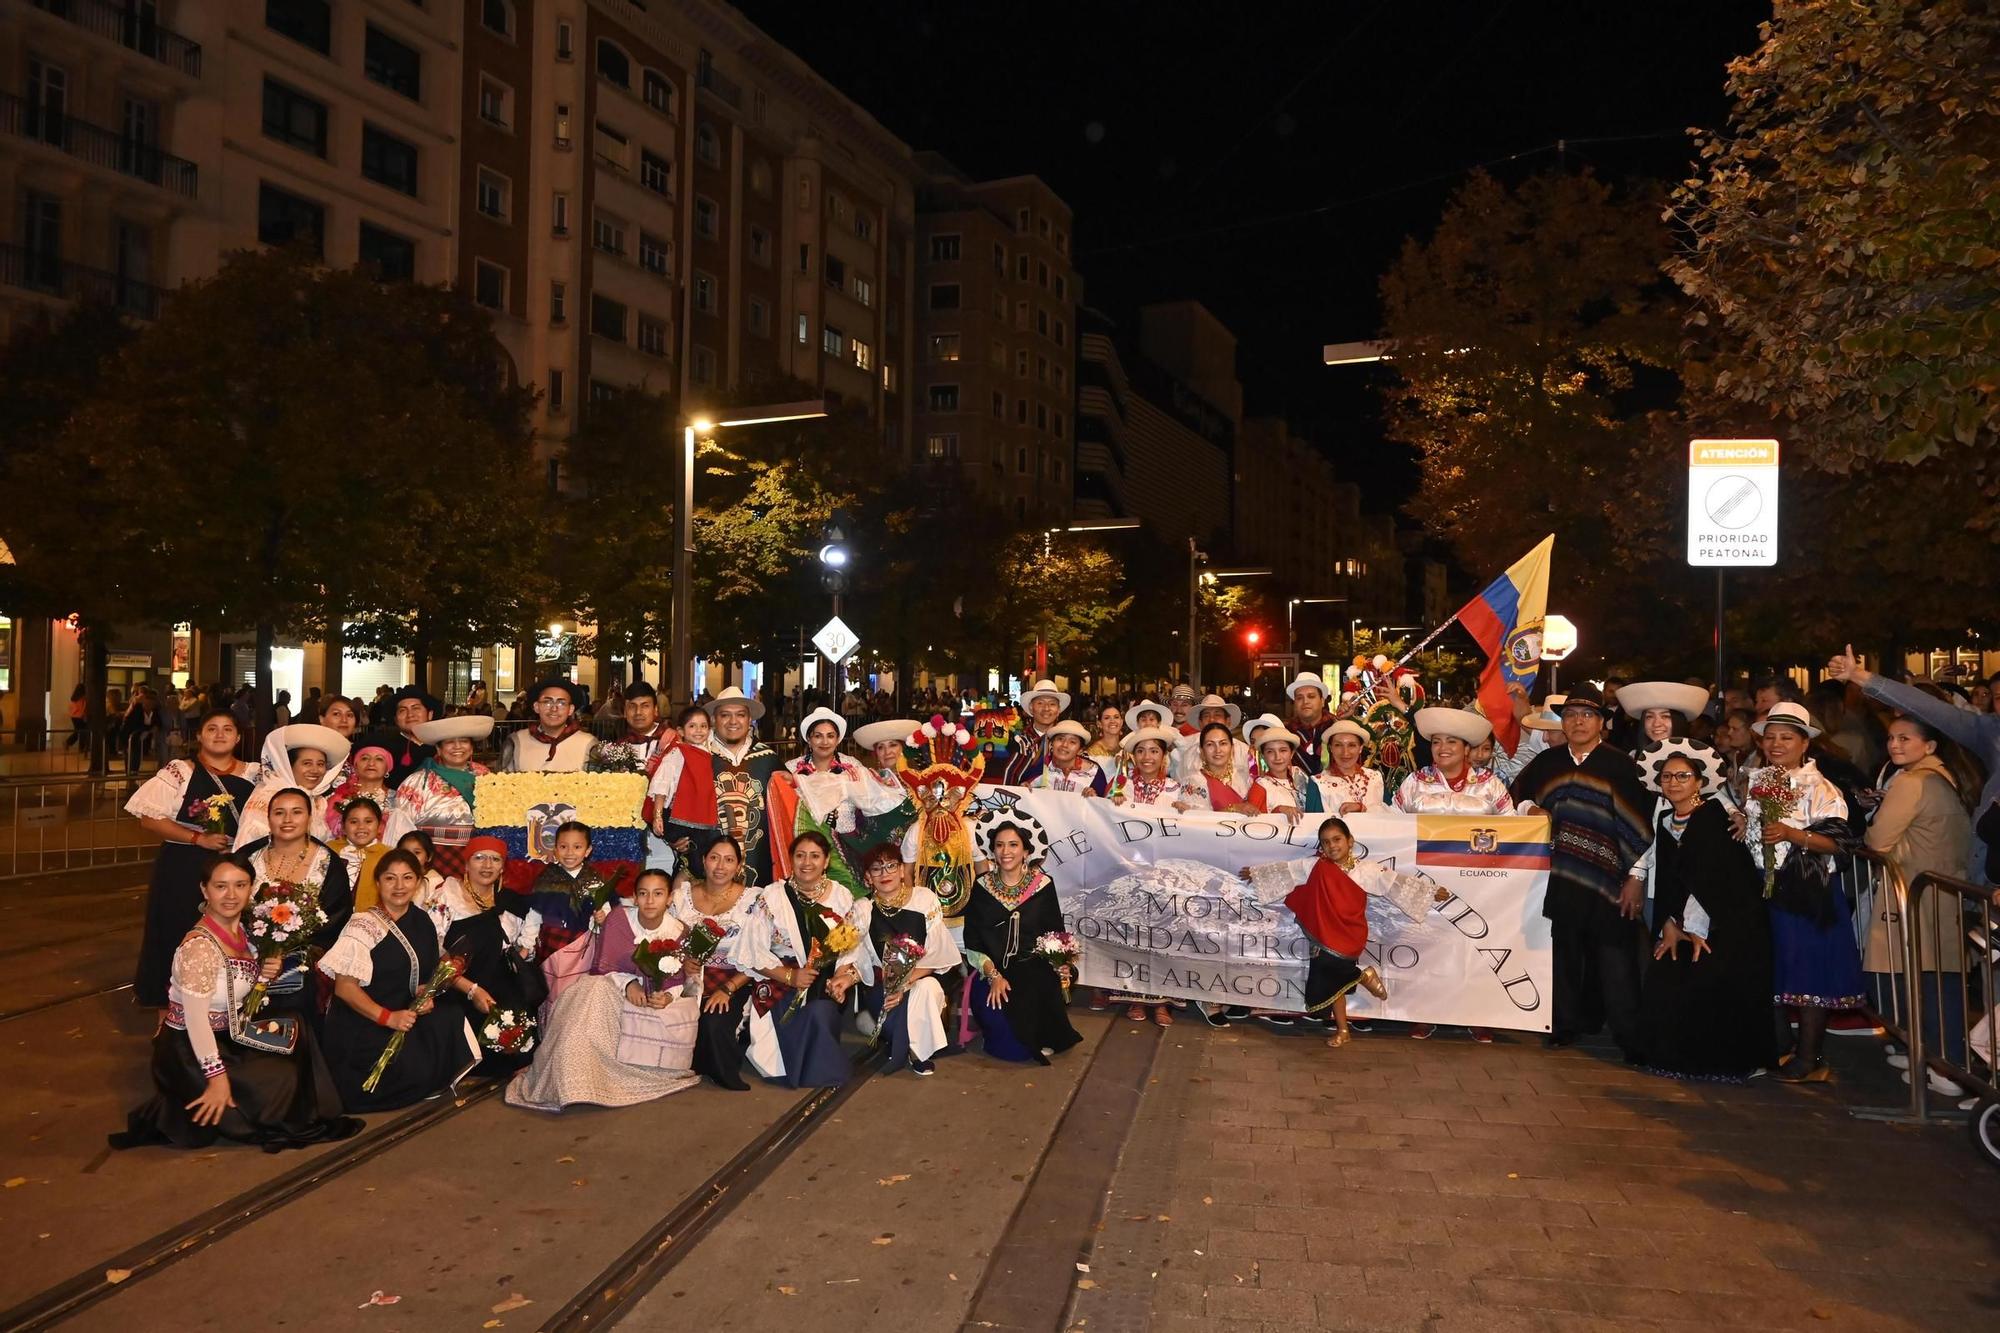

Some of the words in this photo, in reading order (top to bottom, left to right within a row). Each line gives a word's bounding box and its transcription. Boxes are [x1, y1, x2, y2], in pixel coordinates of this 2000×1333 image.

[1699, 448, 1768, 459] ATENCIÓN
[1698, 534, 1768, 543] PRIORIDAD
[1699, 549, 1767, 558] PEATONAL
[826, 632, 846, 648] 30
[1115, 817, 1182, 844] DE
[1459, 869, 1509, 879] ECUADOR
[1144, 891, 1272, 923] MONS.
[1113, 959, 1151, 982] DE
[1161, 968, 1307, 1000] ARAGÓN
